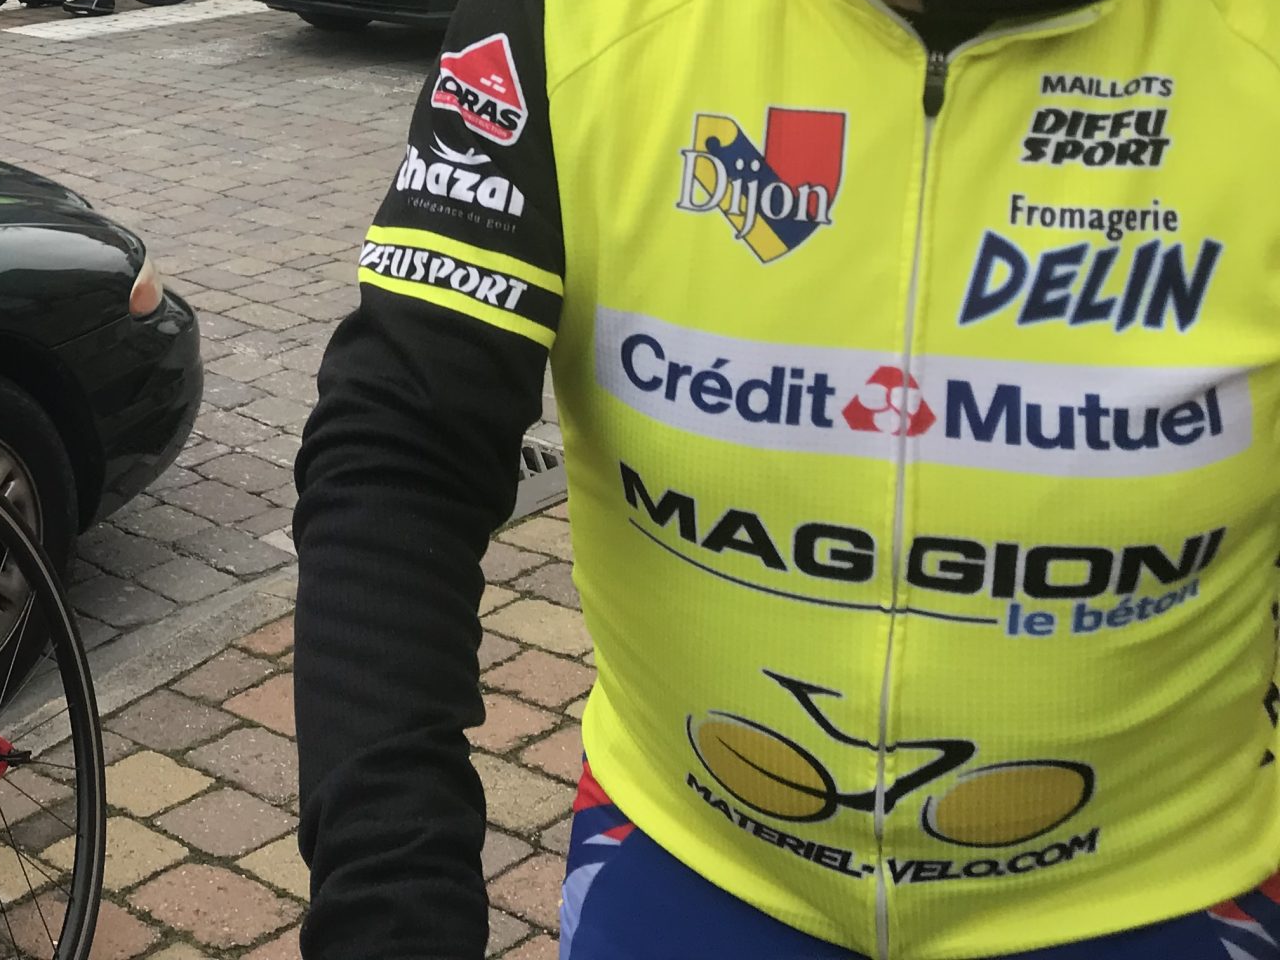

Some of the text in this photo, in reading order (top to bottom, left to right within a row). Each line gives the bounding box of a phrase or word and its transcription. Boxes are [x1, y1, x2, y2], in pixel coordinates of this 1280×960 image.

[436, 75, 522, 131] ORAS
[1041, 75, 1174, 99] MAILLOTS
[1031, 107, 1168, 139] DIFFU
[1022, 137, 1171, 167] SPORT
[467, 211, 481, 223] du
[676, 148, 832, 240] Dijon
[1010, 194, 1179, 240] Fromagerie
[359, 242, 528, 310] IFFUSPORT
[960, 231, 1223, 333] DELIN
[621, 333, 1224, 451] Crédit Mutuel
[1008, 578, 1201, 637] le béton
